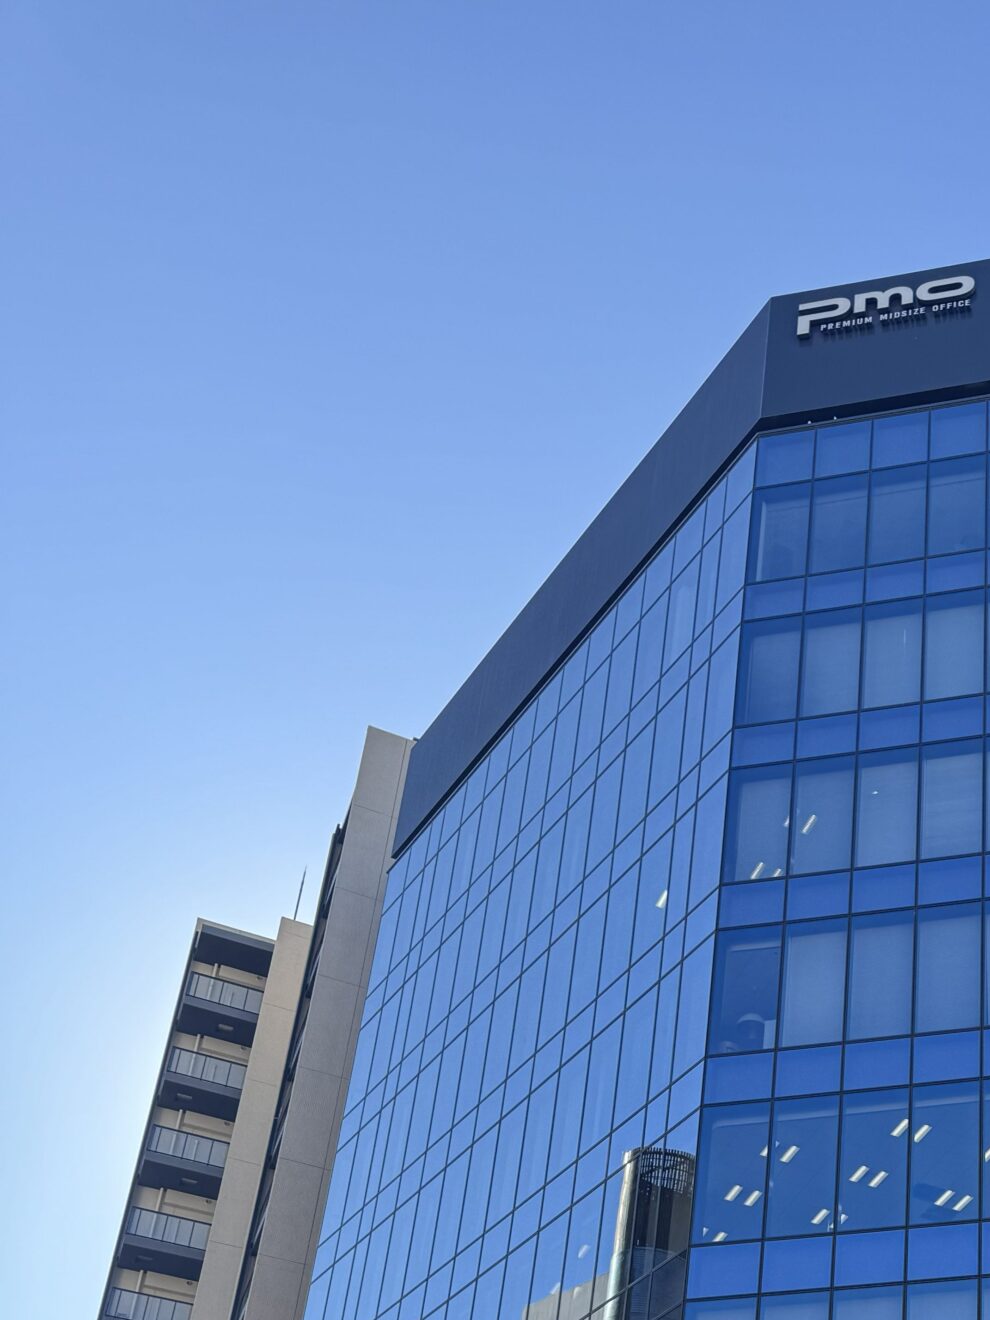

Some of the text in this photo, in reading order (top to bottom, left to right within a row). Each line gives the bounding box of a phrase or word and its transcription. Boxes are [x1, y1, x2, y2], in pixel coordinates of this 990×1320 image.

[820, 299, 971, 331] PREMIUM MIDSIZE OFFICE
